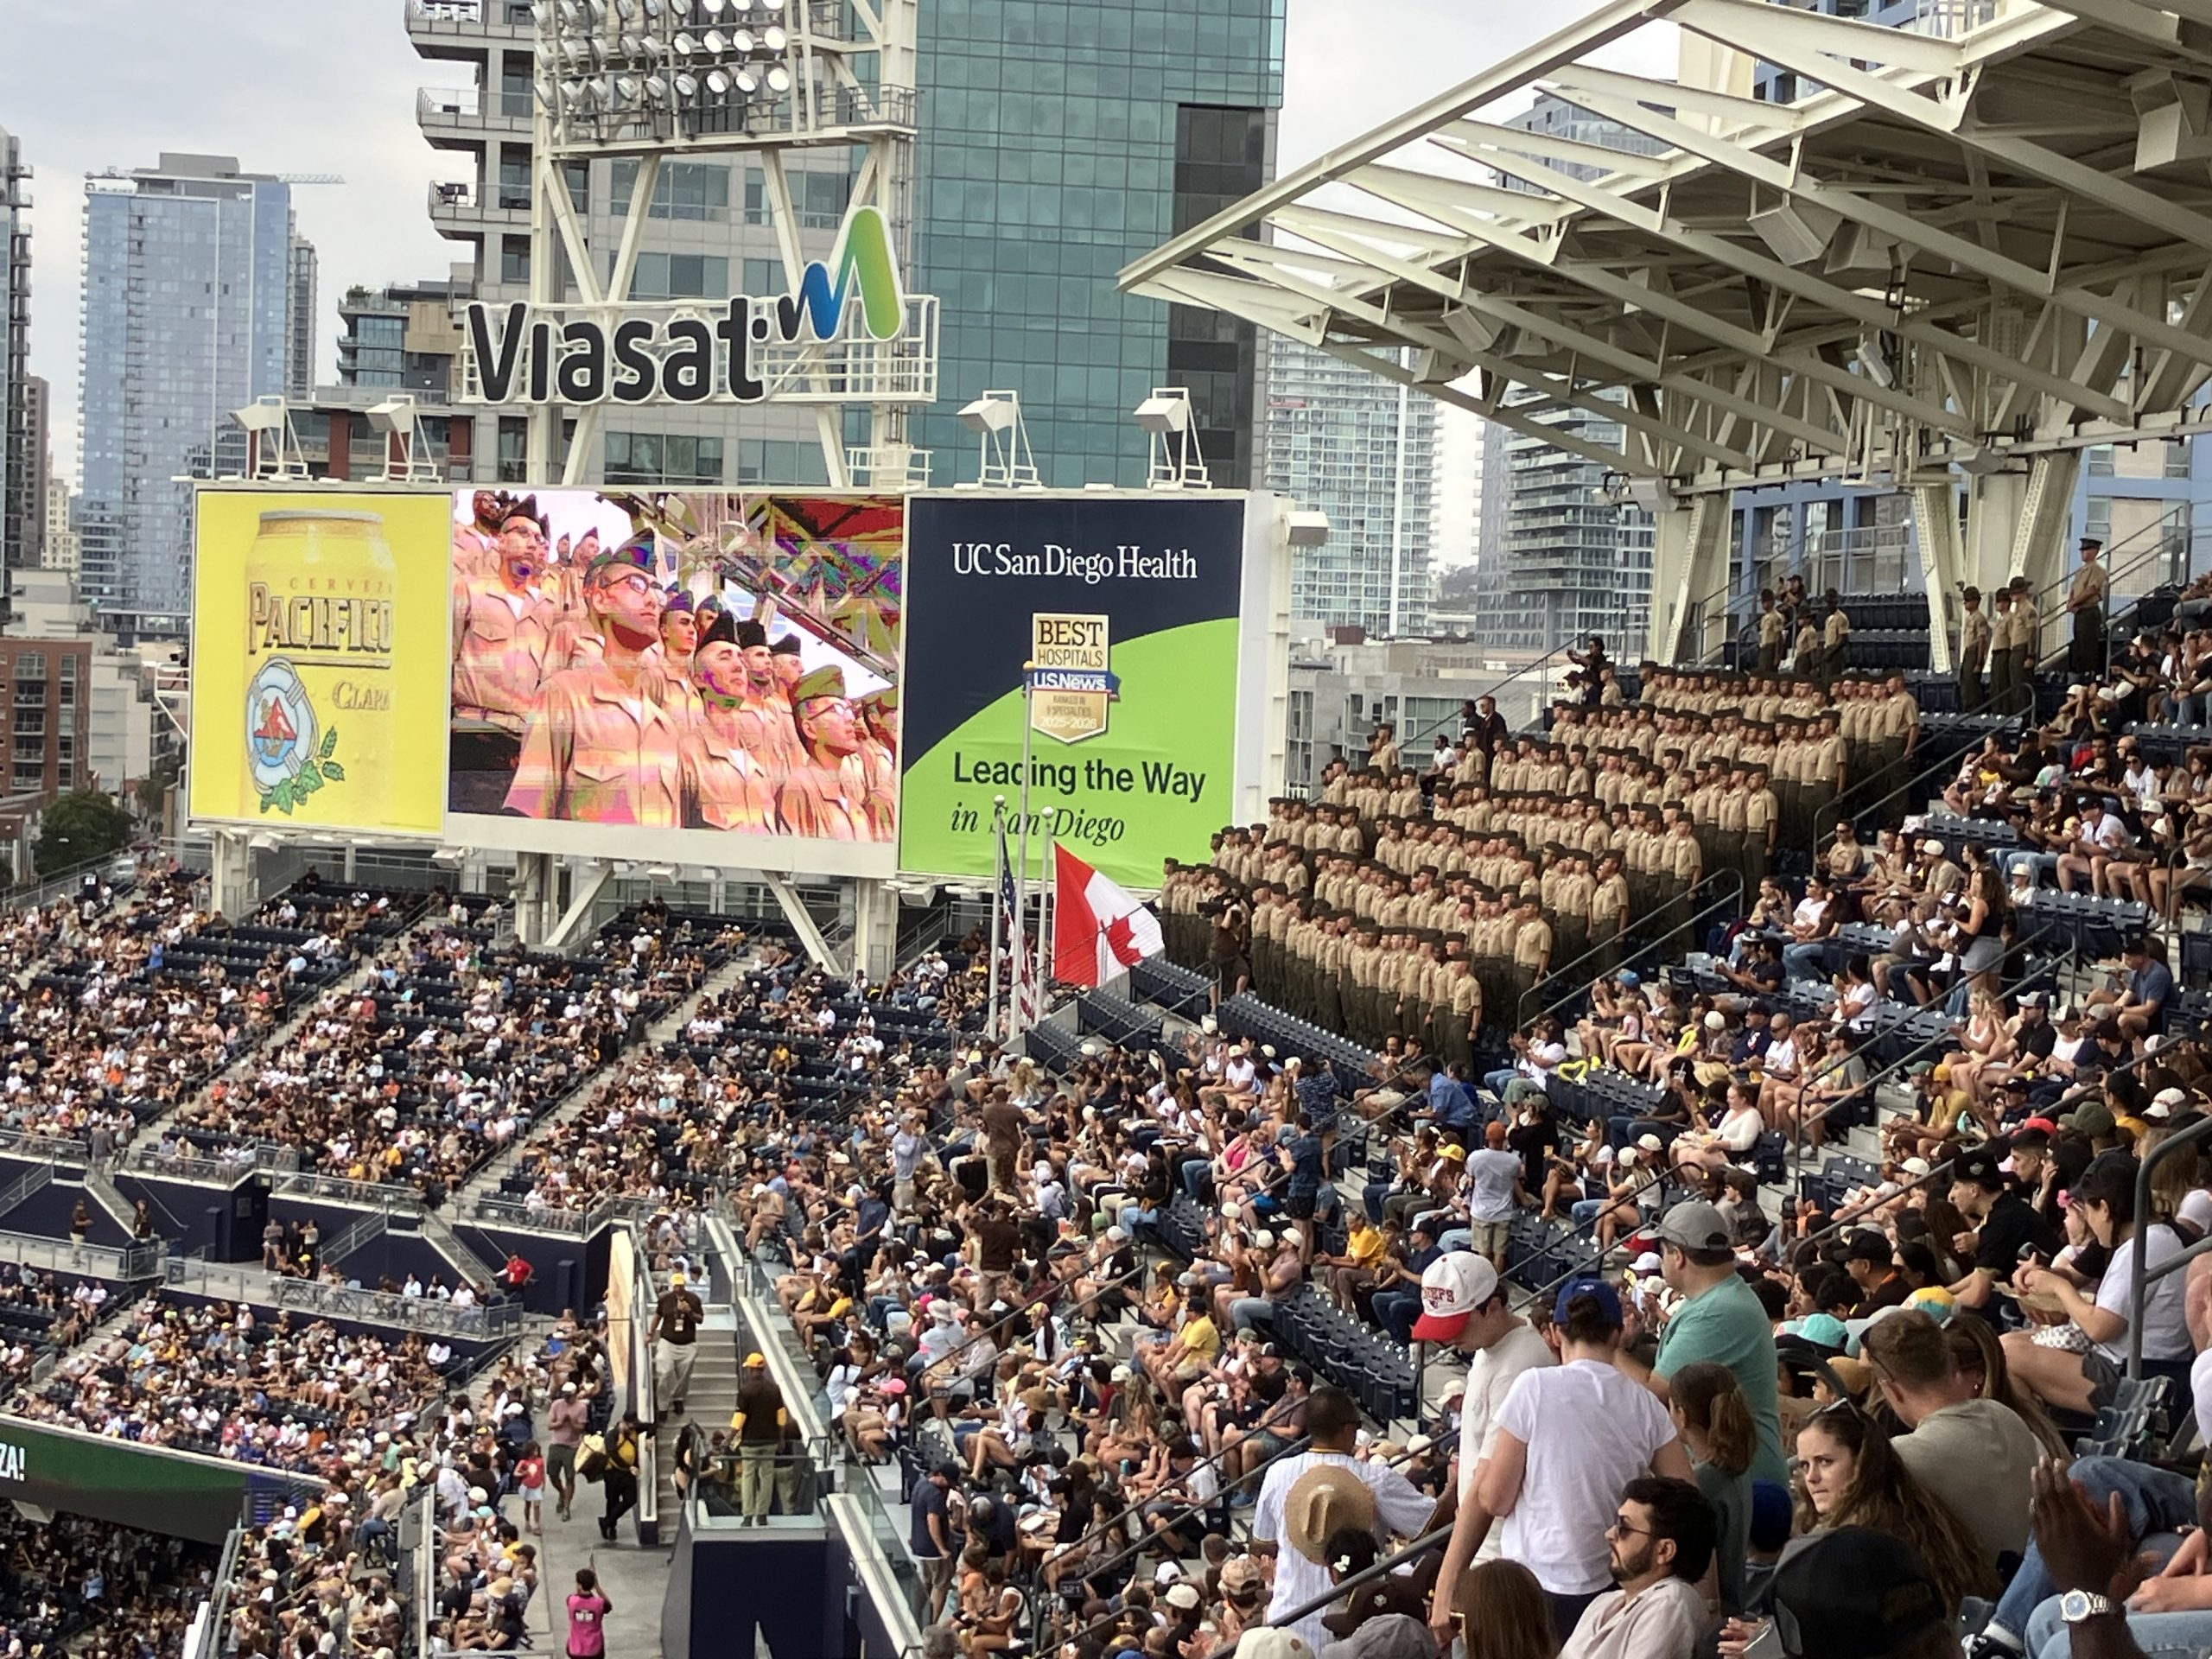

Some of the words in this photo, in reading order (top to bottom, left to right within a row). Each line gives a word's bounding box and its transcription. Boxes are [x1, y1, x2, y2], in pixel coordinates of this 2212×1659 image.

[467, 296, 764, 402] Viasat
[952, 543, 992, 575] UC
[995, 543, 1041, 575] San
[1044, 544, 1114, 584] Diego
[1117, 545, 1198, 578] Health
[249, 582, 392, 655] PACIFICO
[1038, 620, 1103, 647] BEST
[1038, 648, 1103, 668] HOSPITALS
[954, 751, 1077, 796] Leading
[1084, 759, 1135, 792] the
[1141, 761, 1206, 804] Way
[950, 801, 978, 833] in
[1052, 808, 1125, 847] Diego
